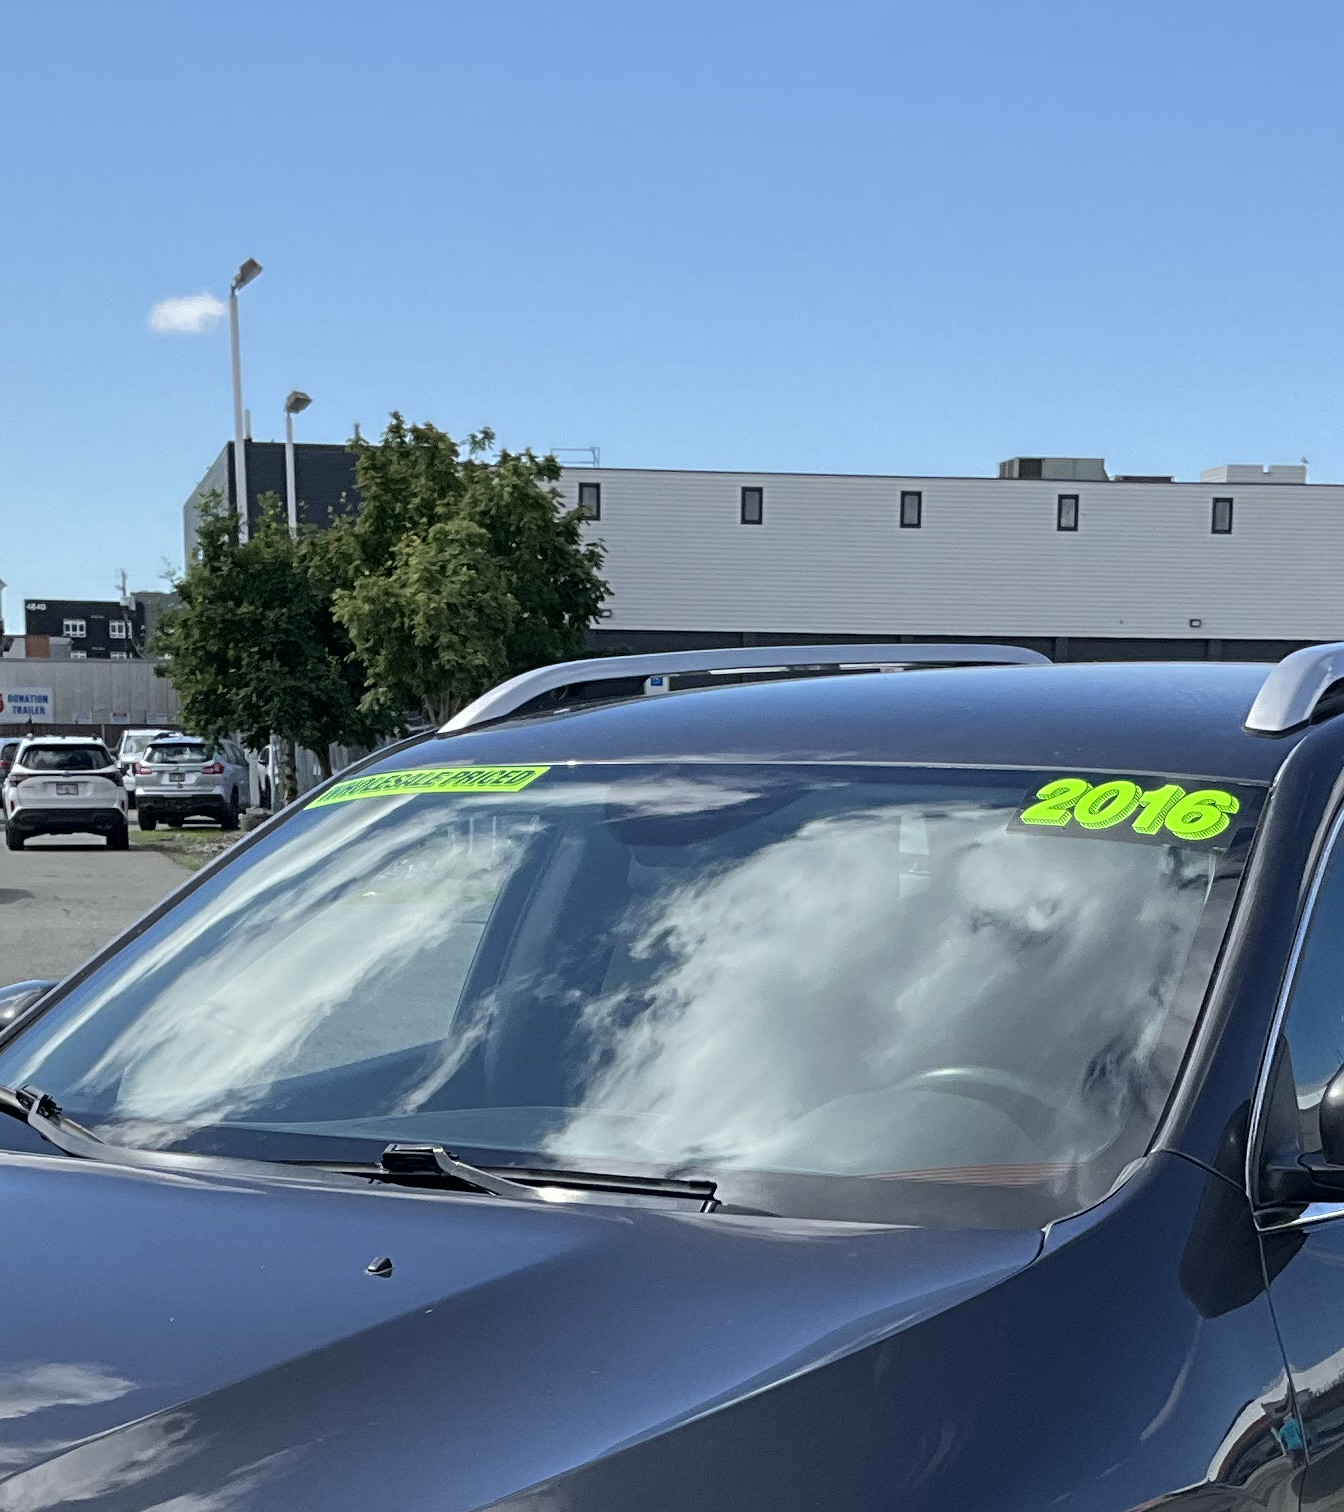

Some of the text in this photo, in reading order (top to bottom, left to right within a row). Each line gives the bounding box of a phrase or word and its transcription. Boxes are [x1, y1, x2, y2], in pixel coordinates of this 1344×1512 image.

[7, 693, 49, 704] DONATION
[12, 705, 46, 715] TRAILER
[316, 769, 537, 804] WHOLESALE PRICED
[1019, 777, 1241, 841] 2016
